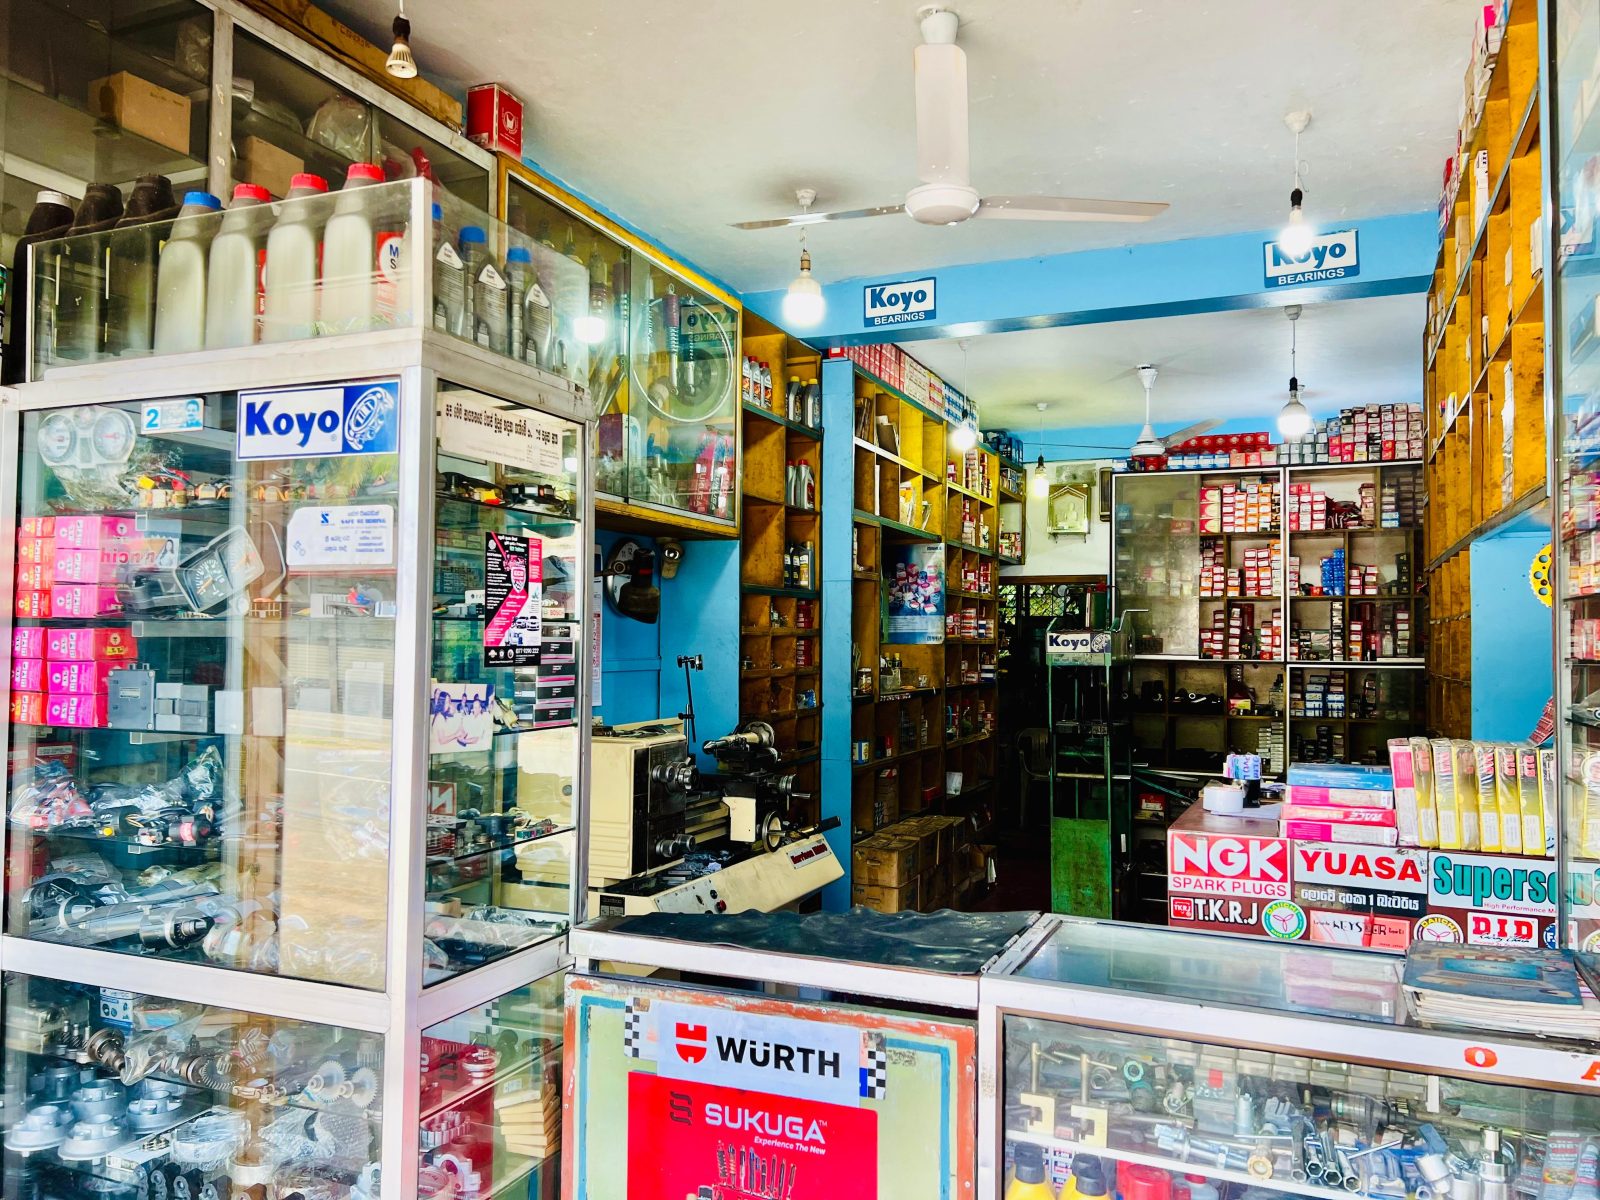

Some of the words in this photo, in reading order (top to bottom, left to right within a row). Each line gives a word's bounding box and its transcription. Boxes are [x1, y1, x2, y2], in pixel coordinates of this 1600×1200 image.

[1278, 268, 1345, 285] BEARINGS
[870, 287, 927, 312] Koyo
[874, 312, 926, 326] BEARINGS
[145, 408, 159, 429] 2
[245, 400, 340, 447] Koyo
[1048, 635, 1090, 651] Koyo
[1173, 836, 1283, 881] NGK
[1299, 850, 1422, 882] YUASA
[1172, 877, 1226, 892] SPARK
[1231, 881, 1287, 897] PLUGS
[1368, 894, 1374, 906] 1
[1502, 904, 1547, 913] Performance
[1195, 899, 1258, 925] T.K.R.J
[1473, 916, 1533, 940] DID
[705, 1103, 825, 1144] SUKUGA
[754, 1136, 794, 1150] Experience
[795, 1143, 809, 1153] The
[810, 1146, 826, 1155] New
